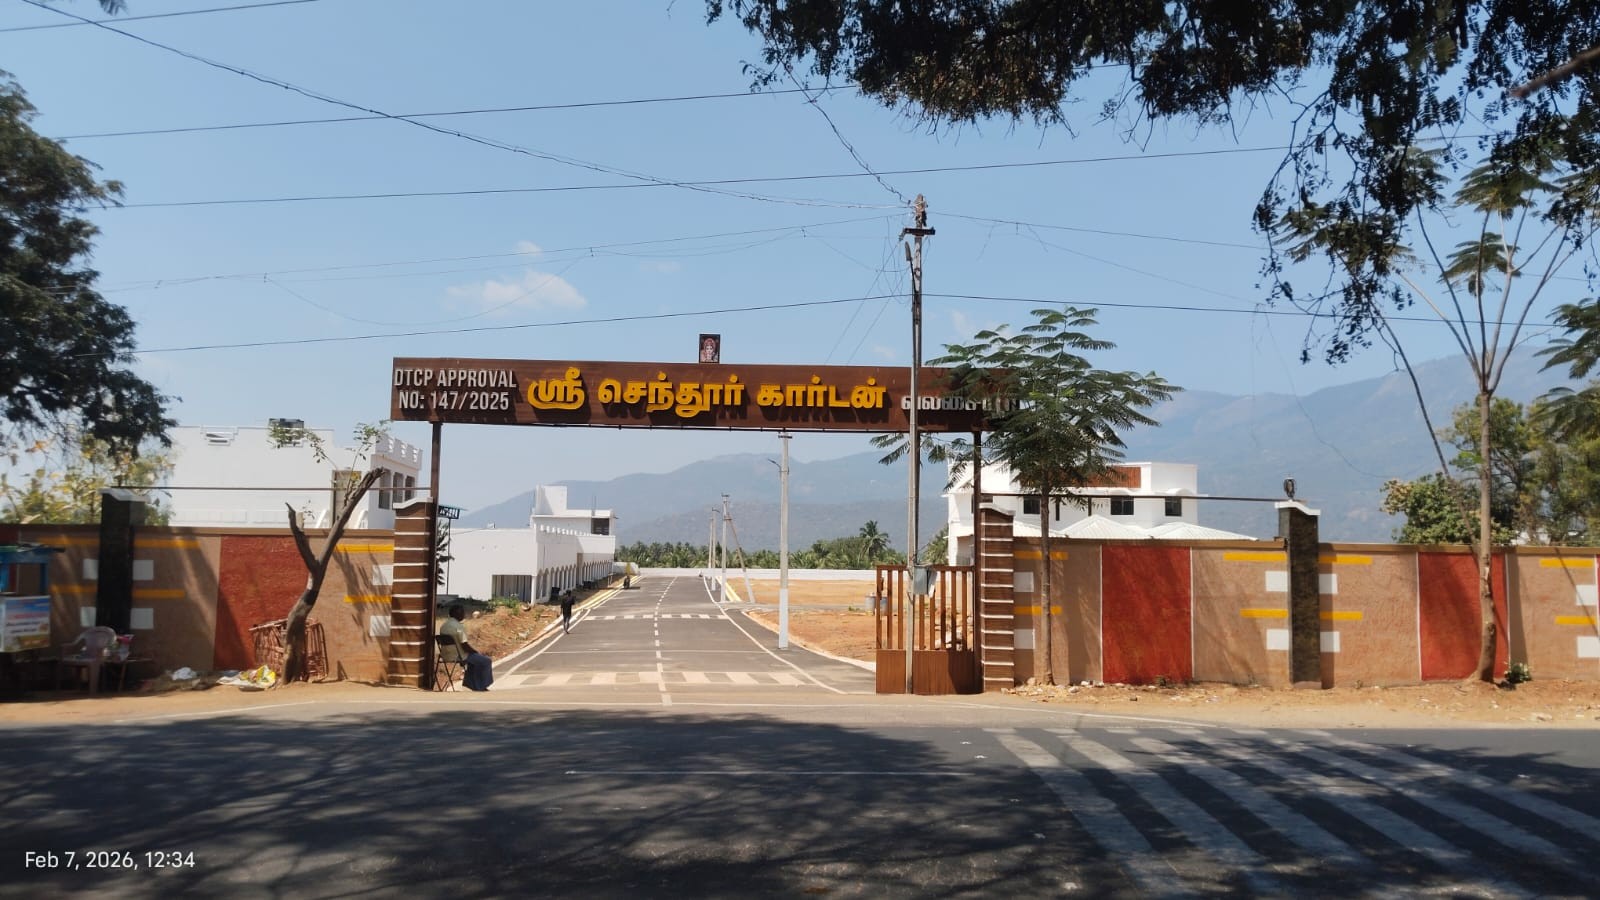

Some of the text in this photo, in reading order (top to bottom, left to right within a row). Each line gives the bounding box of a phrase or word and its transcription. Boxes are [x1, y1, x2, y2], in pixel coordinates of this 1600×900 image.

[394, 368, 517, 388] DTCP APPROVAL
[399, 390, 509, 410] NO: 147/2025
[598, 371, 745, 418] செந்தூர்
[756, 375, 887, 409] கார்டன்
